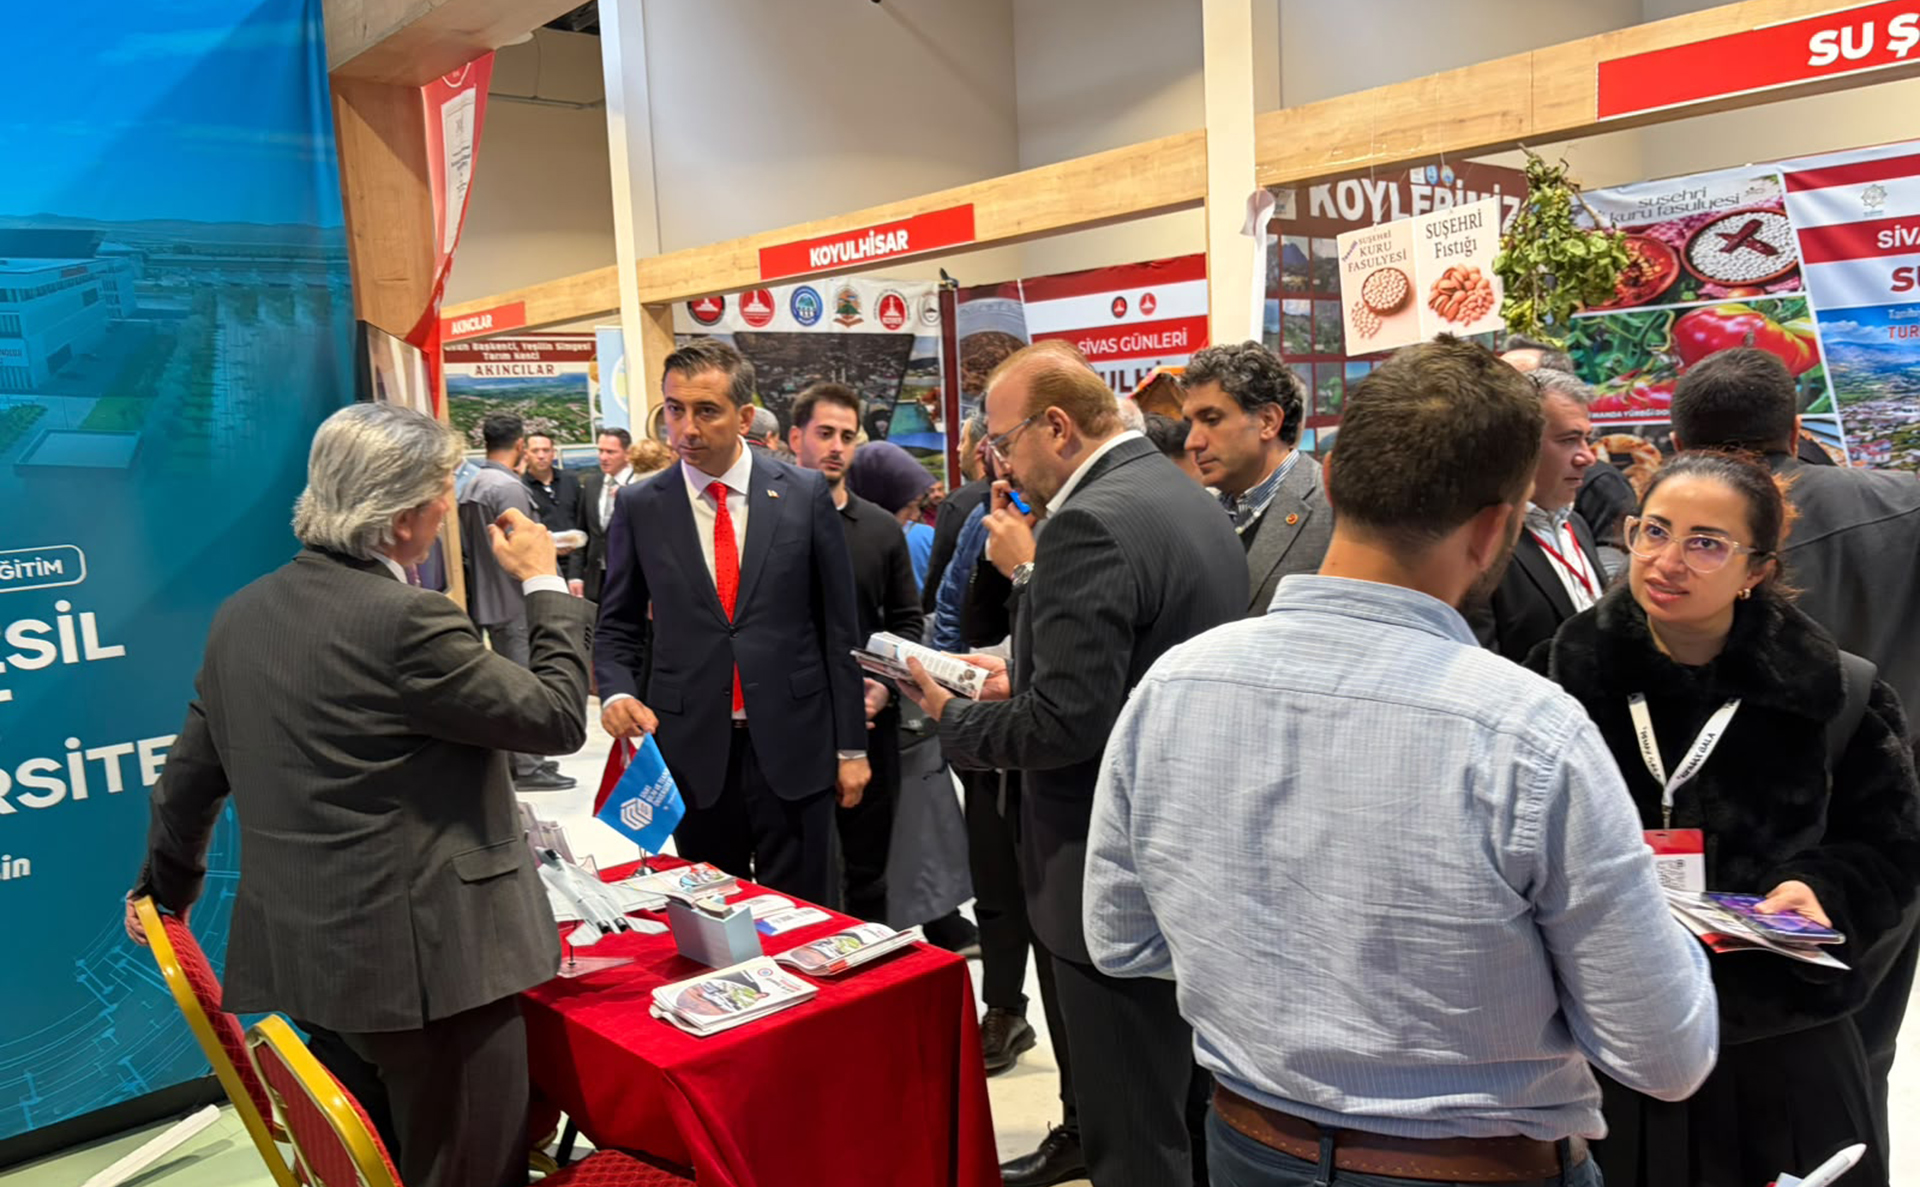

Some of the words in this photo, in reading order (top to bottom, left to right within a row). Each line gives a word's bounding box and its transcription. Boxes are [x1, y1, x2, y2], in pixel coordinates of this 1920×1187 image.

[1807, 20, 1875, 67] SU
[1425, 211, 1483, 240] SUŞEHRİ
[808, 229, 910, 269] KOYULHİSAR
[1347, 247, 1408, 273] FASULYESİ
[1359, 240, 1393, 258] KURU
[1890, 265, 1920, 293] S
[451, 315, 493, 335] AKINCILAR
[1077, 339, 1118, 356] SİVAS
[1119, 327, 1188, 352] GÜNLERİ
[476, 365, 554, 376] AKINCILAR
[0, 599, 126, 673] SİL
[0, 854, 31, 880] in
